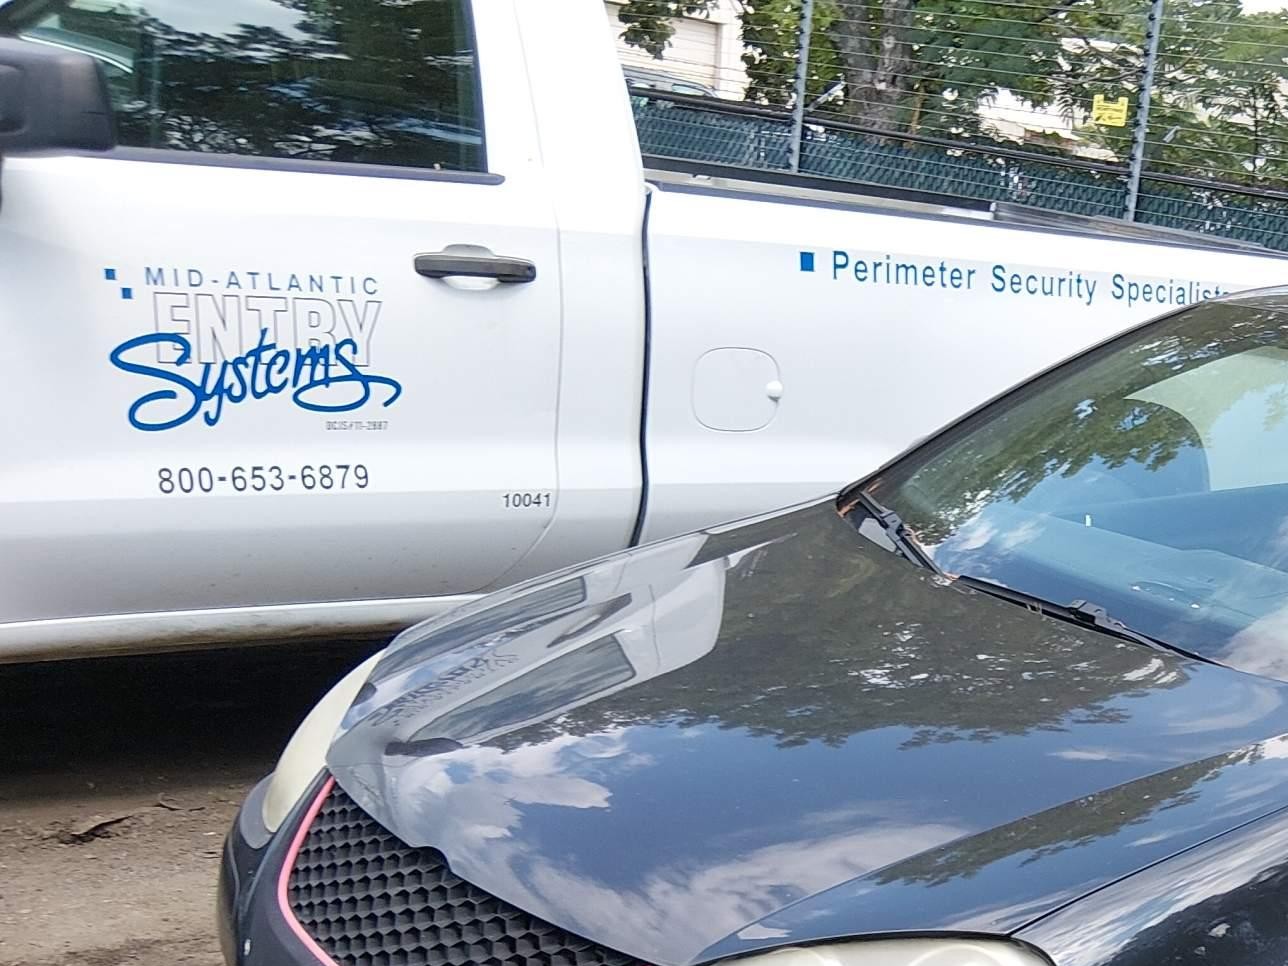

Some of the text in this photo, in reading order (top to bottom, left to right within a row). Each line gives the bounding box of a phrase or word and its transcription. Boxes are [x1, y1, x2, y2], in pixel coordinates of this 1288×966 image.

[144, 266, 380, 295] MID-ATLANTIC
[832, 250, 976, 290] Perimeter
[991, 264, 1097, 306] Security
[153, 291, 383, 368] ENTRY
[109, 327, 402, 432] Systems
[157, 464, 370, 494] 800-653-6879
[502, 492, 552, 508] 10041
